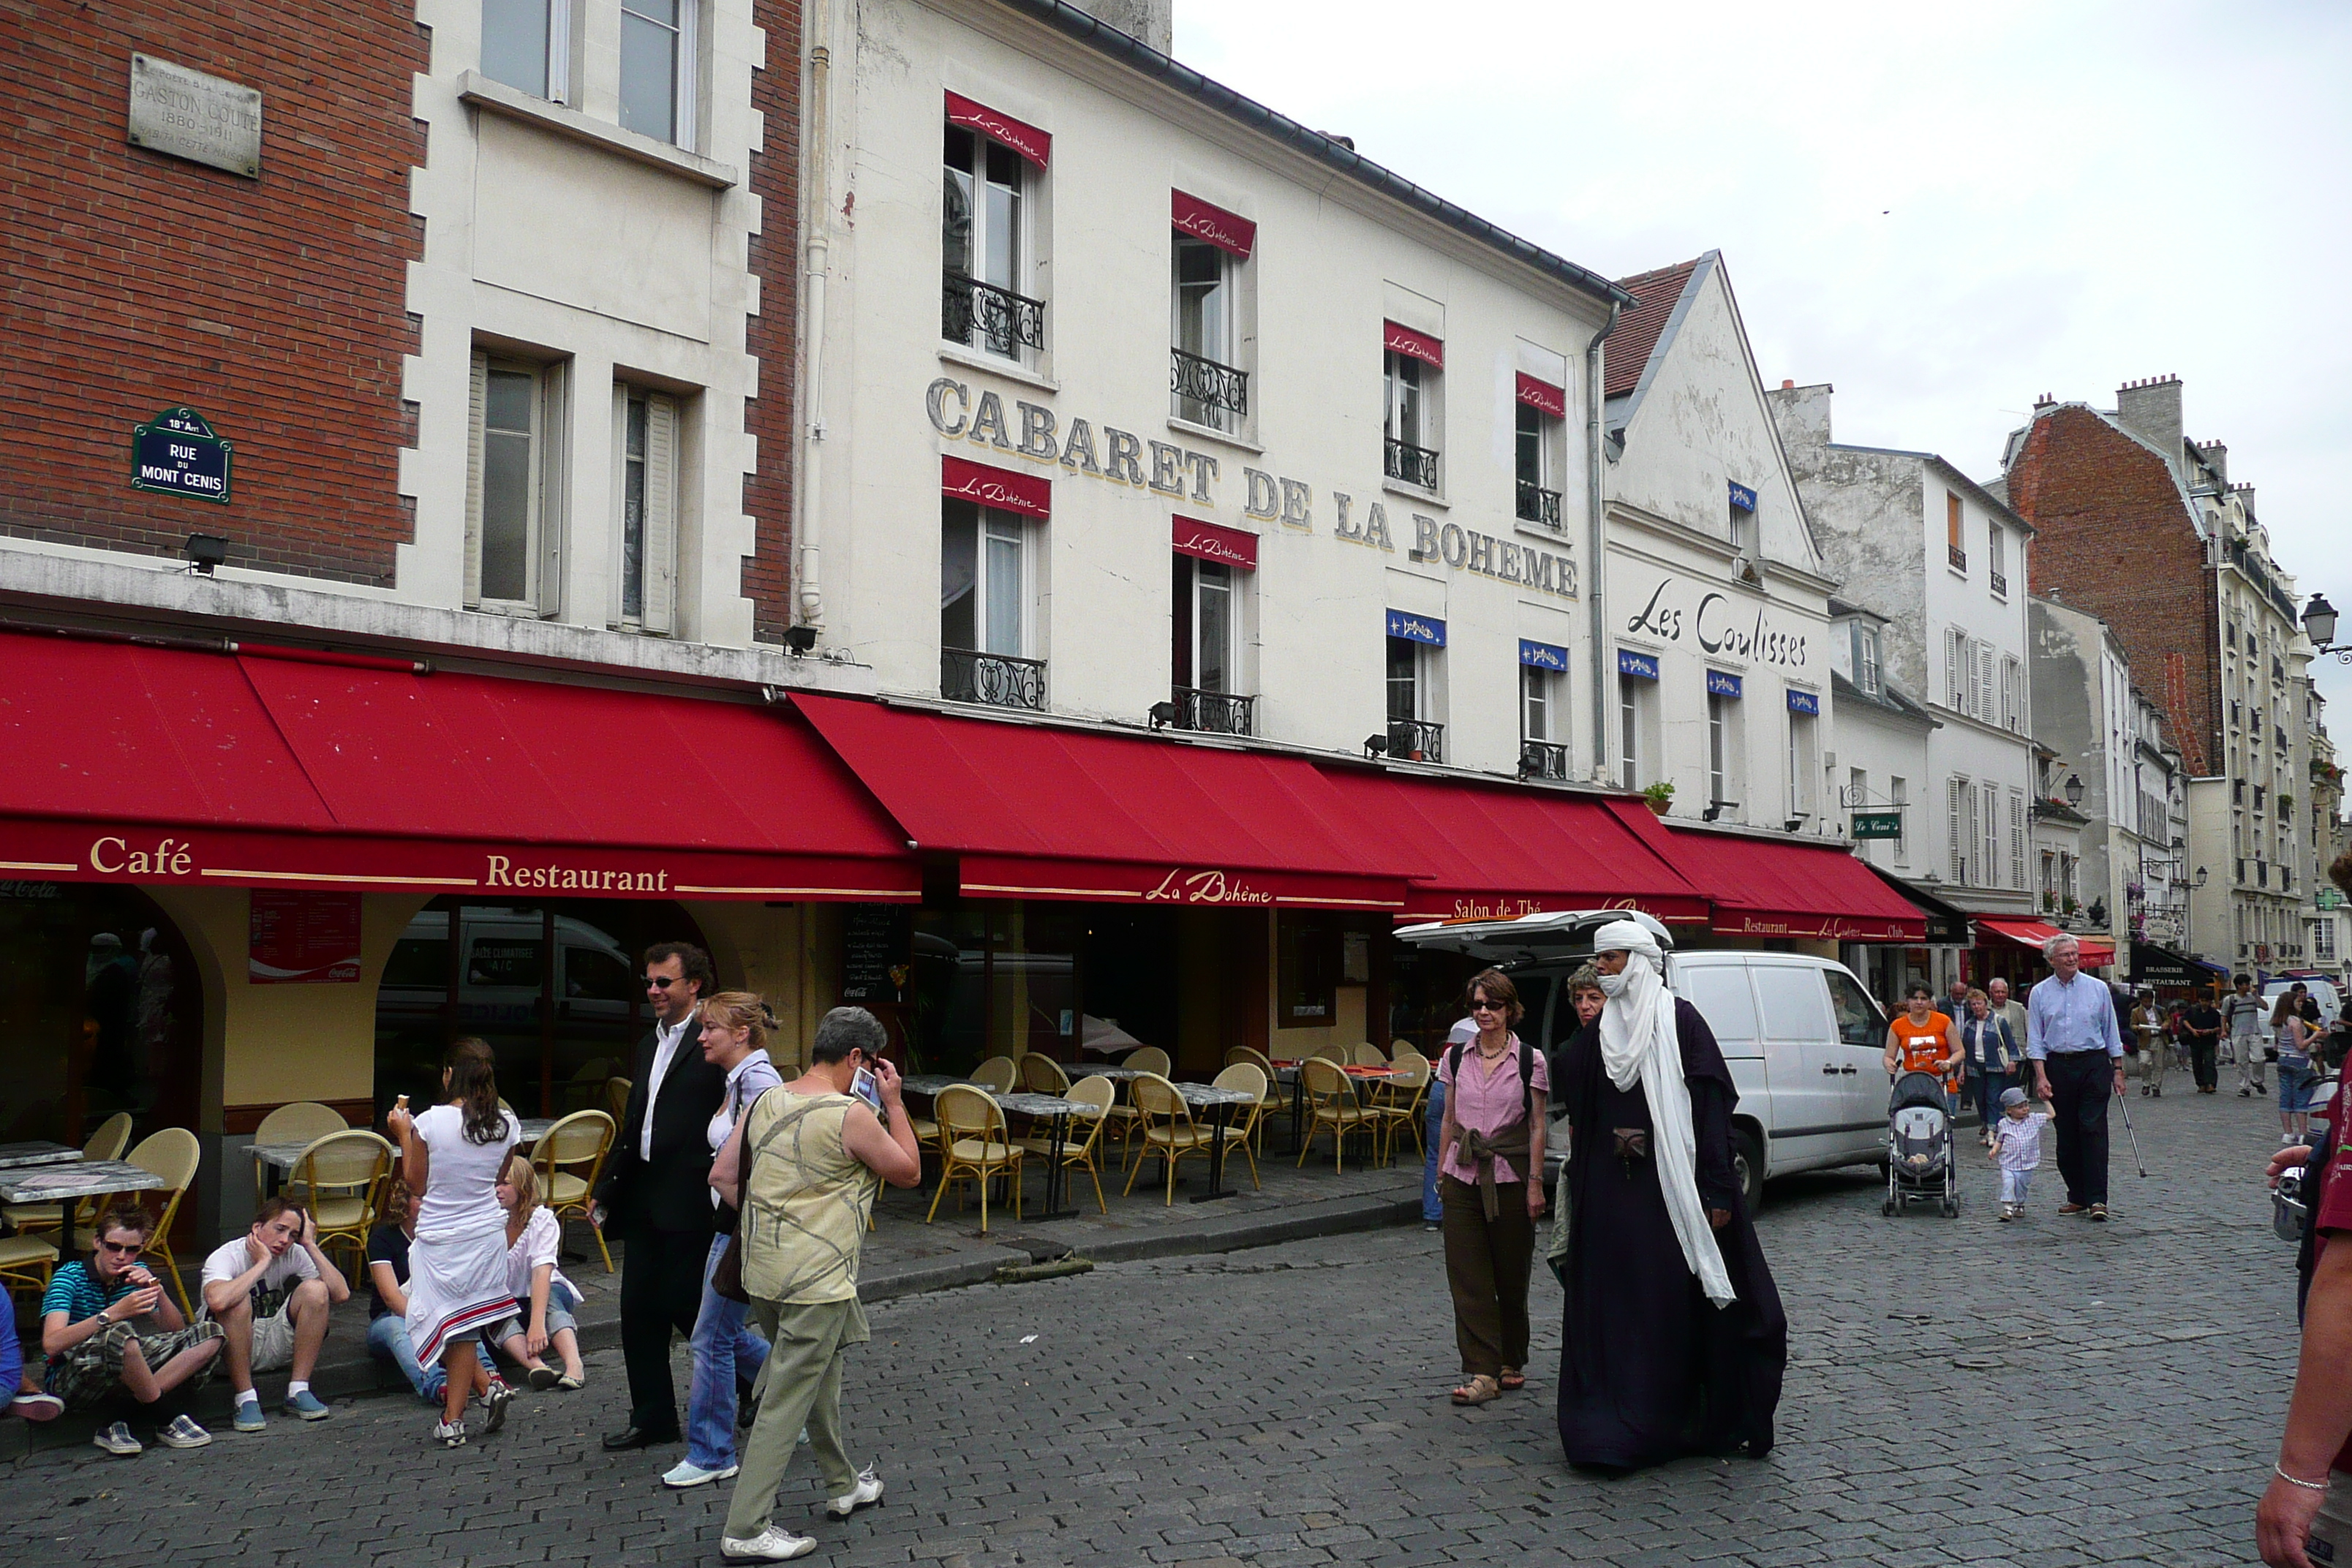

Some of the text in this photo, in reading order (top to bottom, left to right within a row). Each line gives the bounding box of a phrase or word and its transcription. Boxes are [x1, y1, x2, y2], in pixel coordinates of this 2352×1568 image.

[134, 81, 258, 132] GASTON COUTÉ
[139, 126, 174, 143] HABITA
[178, 137, 208, 153] CETTE
[170, 444, 197, 461] RUE
[177, 461, 189, 469] DU
[141, 464, 222, 491] MONT CENIS
[925, 376, 1580, 602] CABARET DE LA BOHEME
[1628, 578, 1806, 667] Les Coulisses
[90, 837, 668, 892] Café Restaurant
[1145, 867, 1273, 902] La Bohème
[1454, 899, 1541, 919] Salon de Thé
[1744, 917, 1787, 934] Restaurant
[1888, 924, 1904, 938] Club
